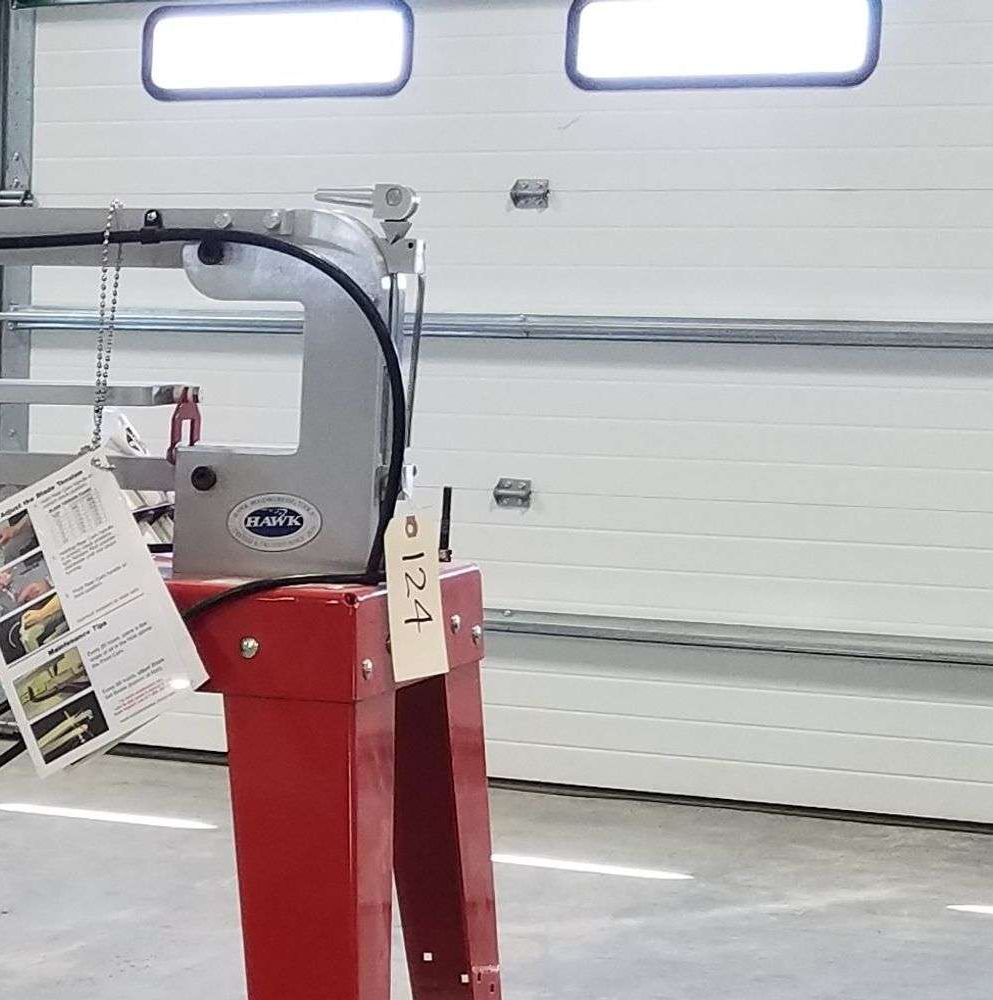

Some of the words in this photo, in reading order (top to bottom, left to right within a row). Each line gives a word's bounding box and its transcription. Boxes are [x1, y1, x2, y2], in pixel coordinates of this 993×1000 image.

[0, 504, 22, 518] Adjust
[23, 497, 34, 505] the
[35, 485, 55, 498] Blade
[56, 470, 83, 486] Tension
[245, 513, 302, 528] HAWK
[402, 552, 433, 633] 124
[47, 630, 91, 655] Maintenance
[92, 621, 107, 631] Tips
